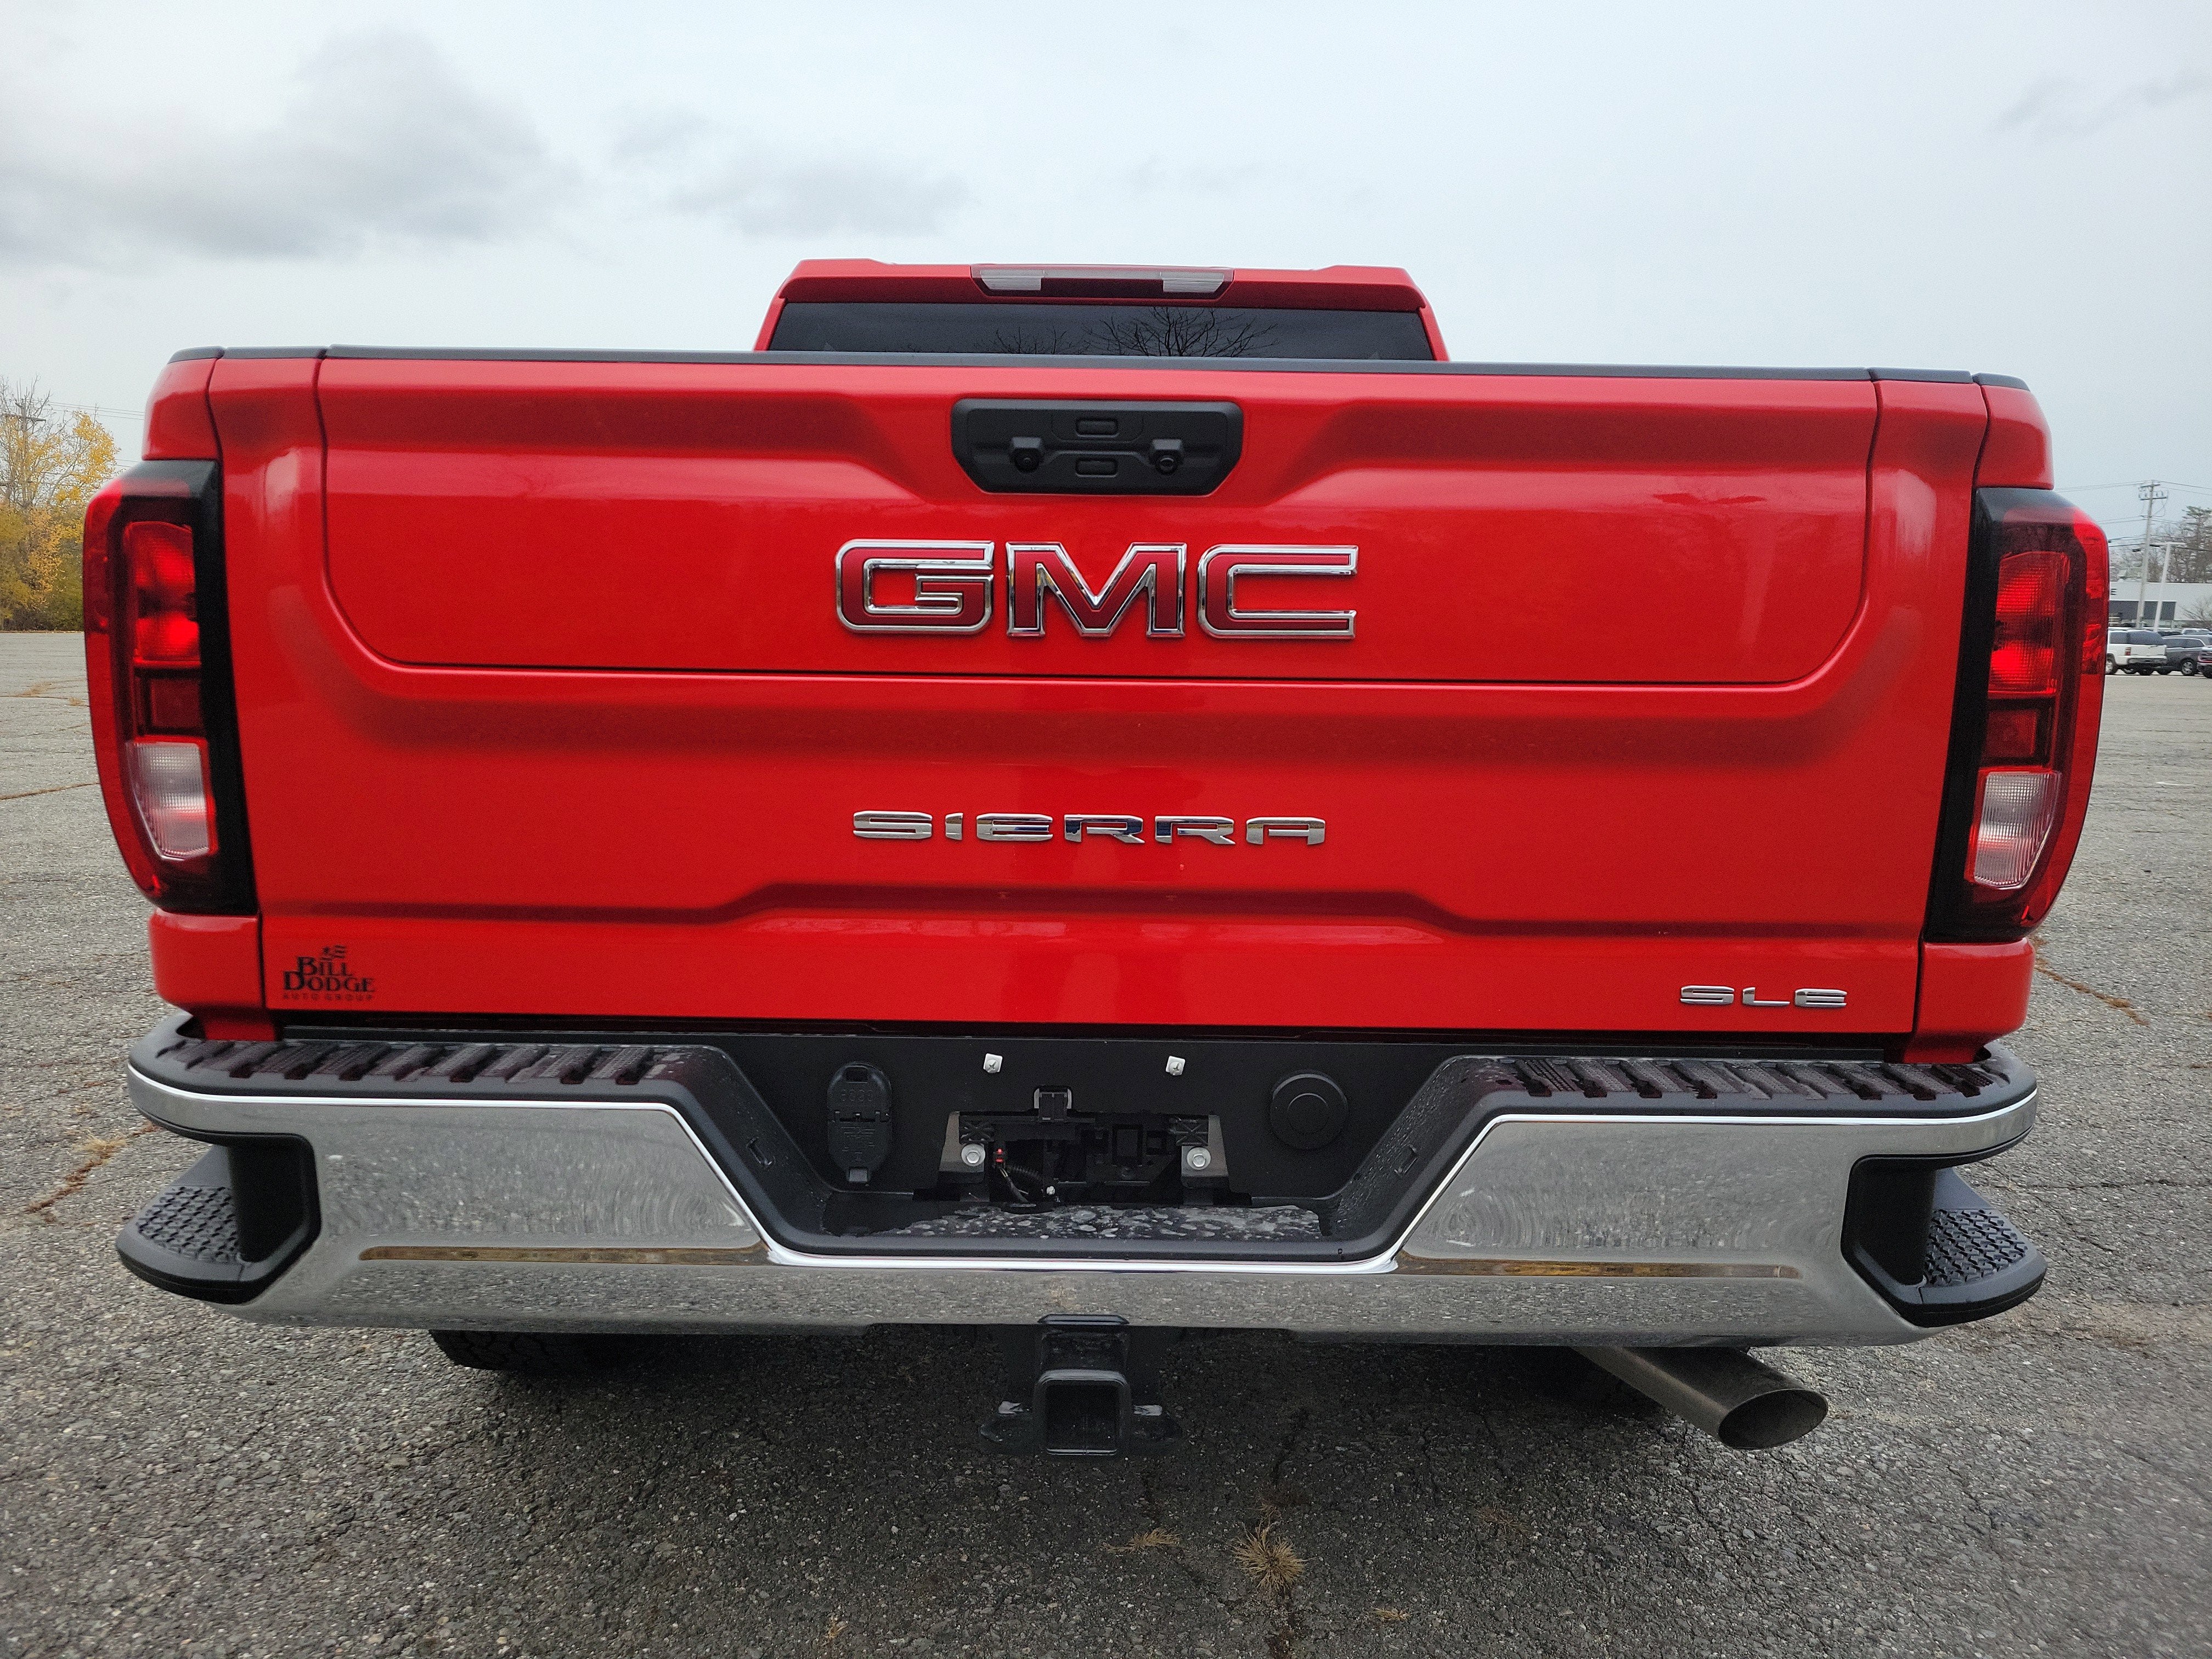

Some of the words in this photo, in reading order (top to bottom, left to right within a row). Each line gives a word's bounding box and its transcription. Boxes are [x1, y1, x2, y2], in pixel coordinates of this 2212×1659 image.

[835, 539, 1358, 640] GMC
[853, 810, 1326, 845] SIERRA
[1680, 985, 1847, 1007] SLE
